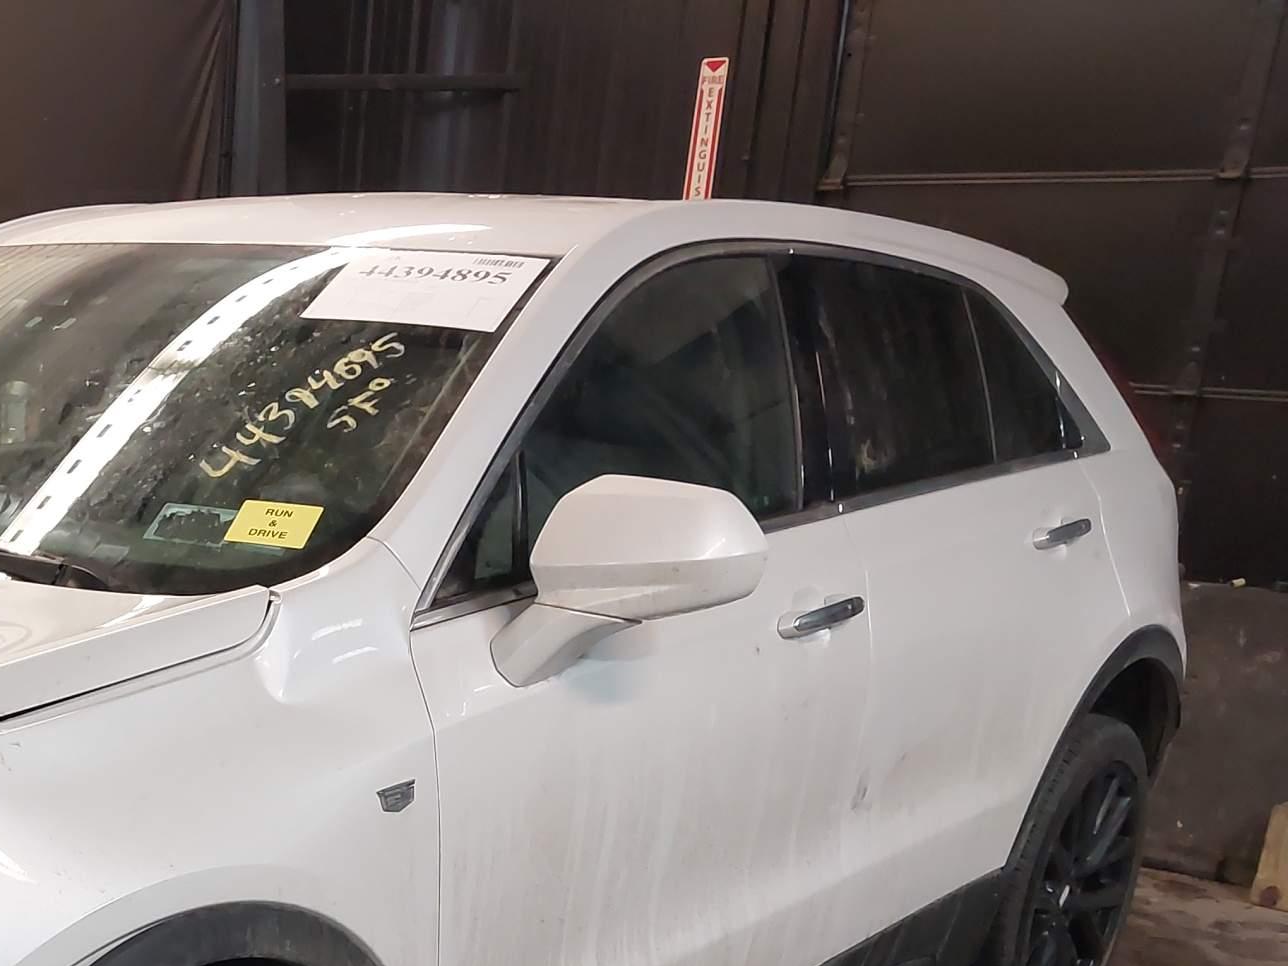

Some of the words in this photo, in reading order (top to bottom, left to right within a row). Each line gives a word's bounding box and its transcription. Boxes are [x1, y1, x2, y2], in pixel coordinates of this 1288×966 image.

[701, 75, 724, 85] FIRE
[360, 264, 512, 285] 44394895
[265, 508, 293, 518] RUN
[268, 519, 278, 528] &
[248, 528, 288, 540] DRIVE
